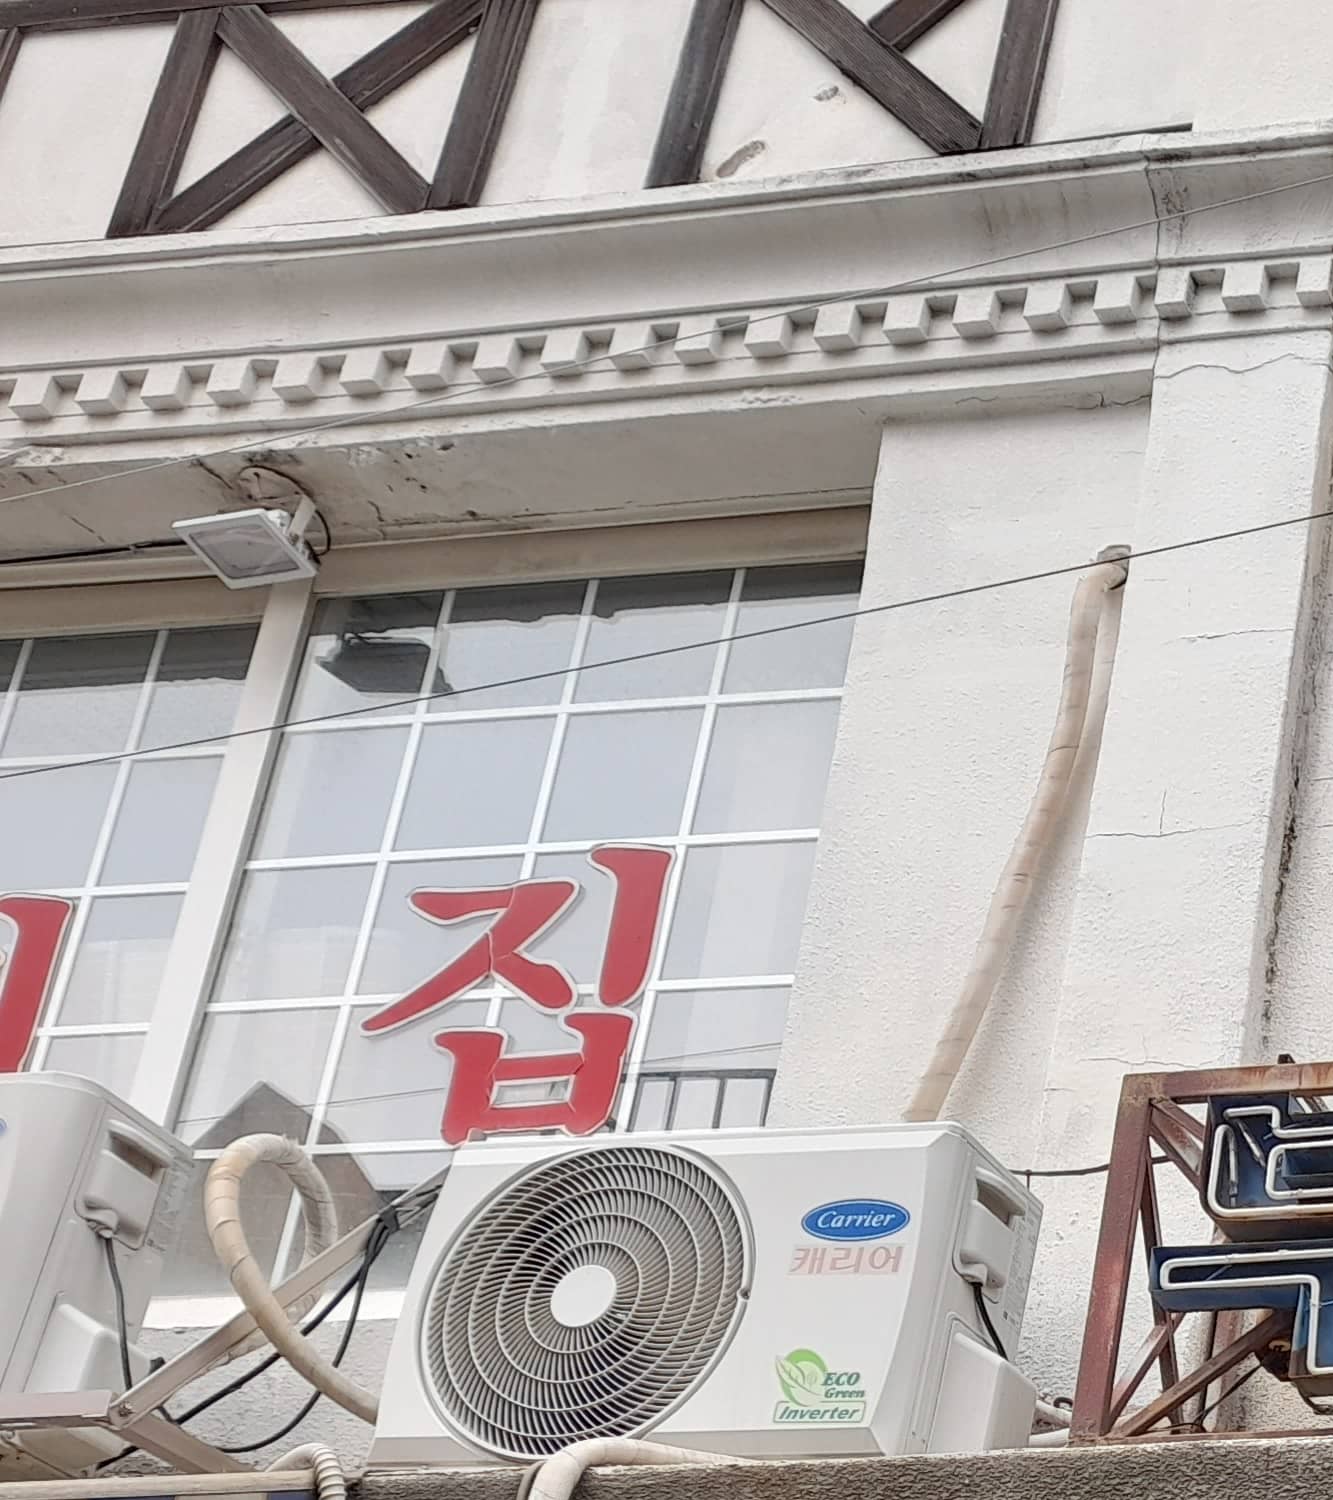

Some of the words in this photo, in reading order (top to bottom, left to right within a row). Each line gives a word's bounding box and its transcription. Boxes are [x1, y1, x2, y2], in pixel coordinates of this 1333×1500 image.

[816, 1210, 896, 1229] Carrier
[788, 1245, 904, 1274] 캐리어
[821, 1372, 861, 1387] ECO
[824, 1387, 865, 1399] Green
[778, 1406, 860, 1420] Inverter
